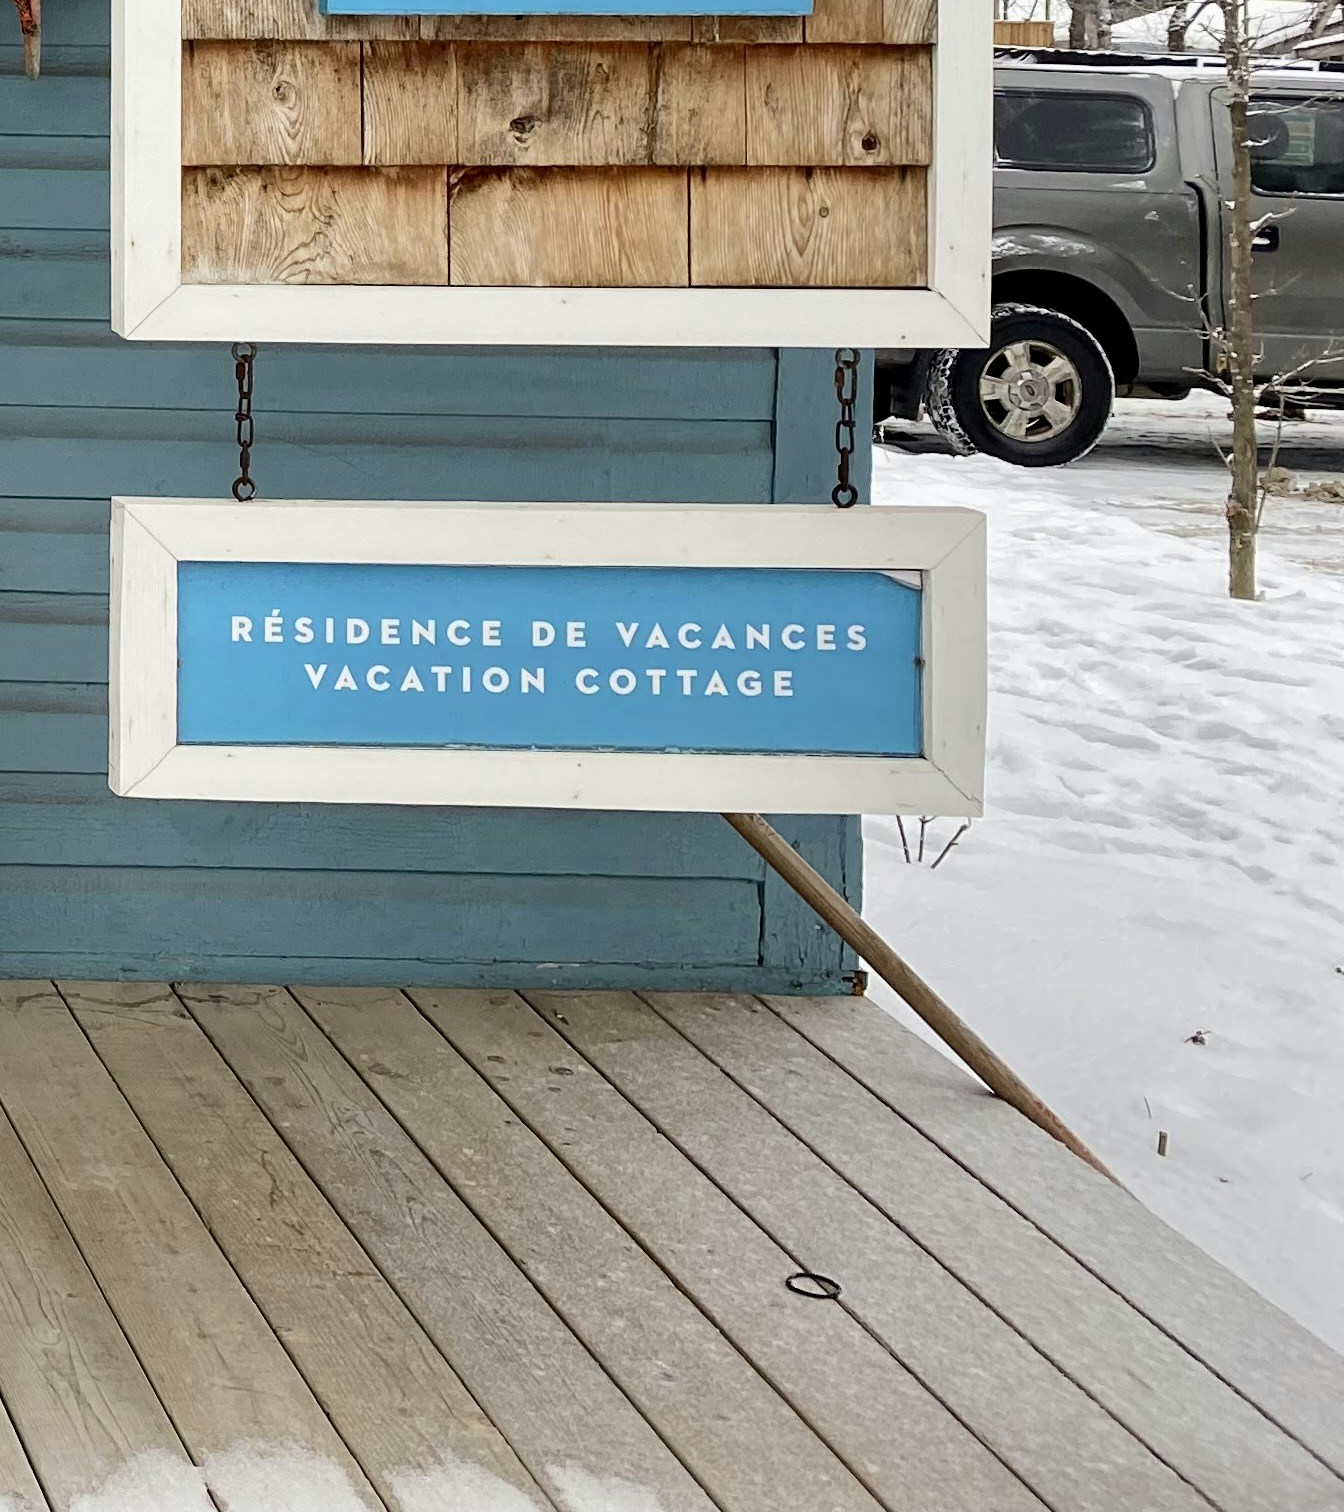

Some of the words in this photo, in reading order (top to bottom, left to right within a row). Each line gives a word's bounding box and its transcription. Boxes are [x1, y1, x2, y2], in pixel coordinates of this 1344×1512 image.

[231, 608, 503, 647] RÉSIDENCE
[532, 621, 586, 648] DE
[615, 622, 867, 651] VACANCES
[304, 663, 546, 694] VACATION
[574, 667, 794, 696] COTTAGE
